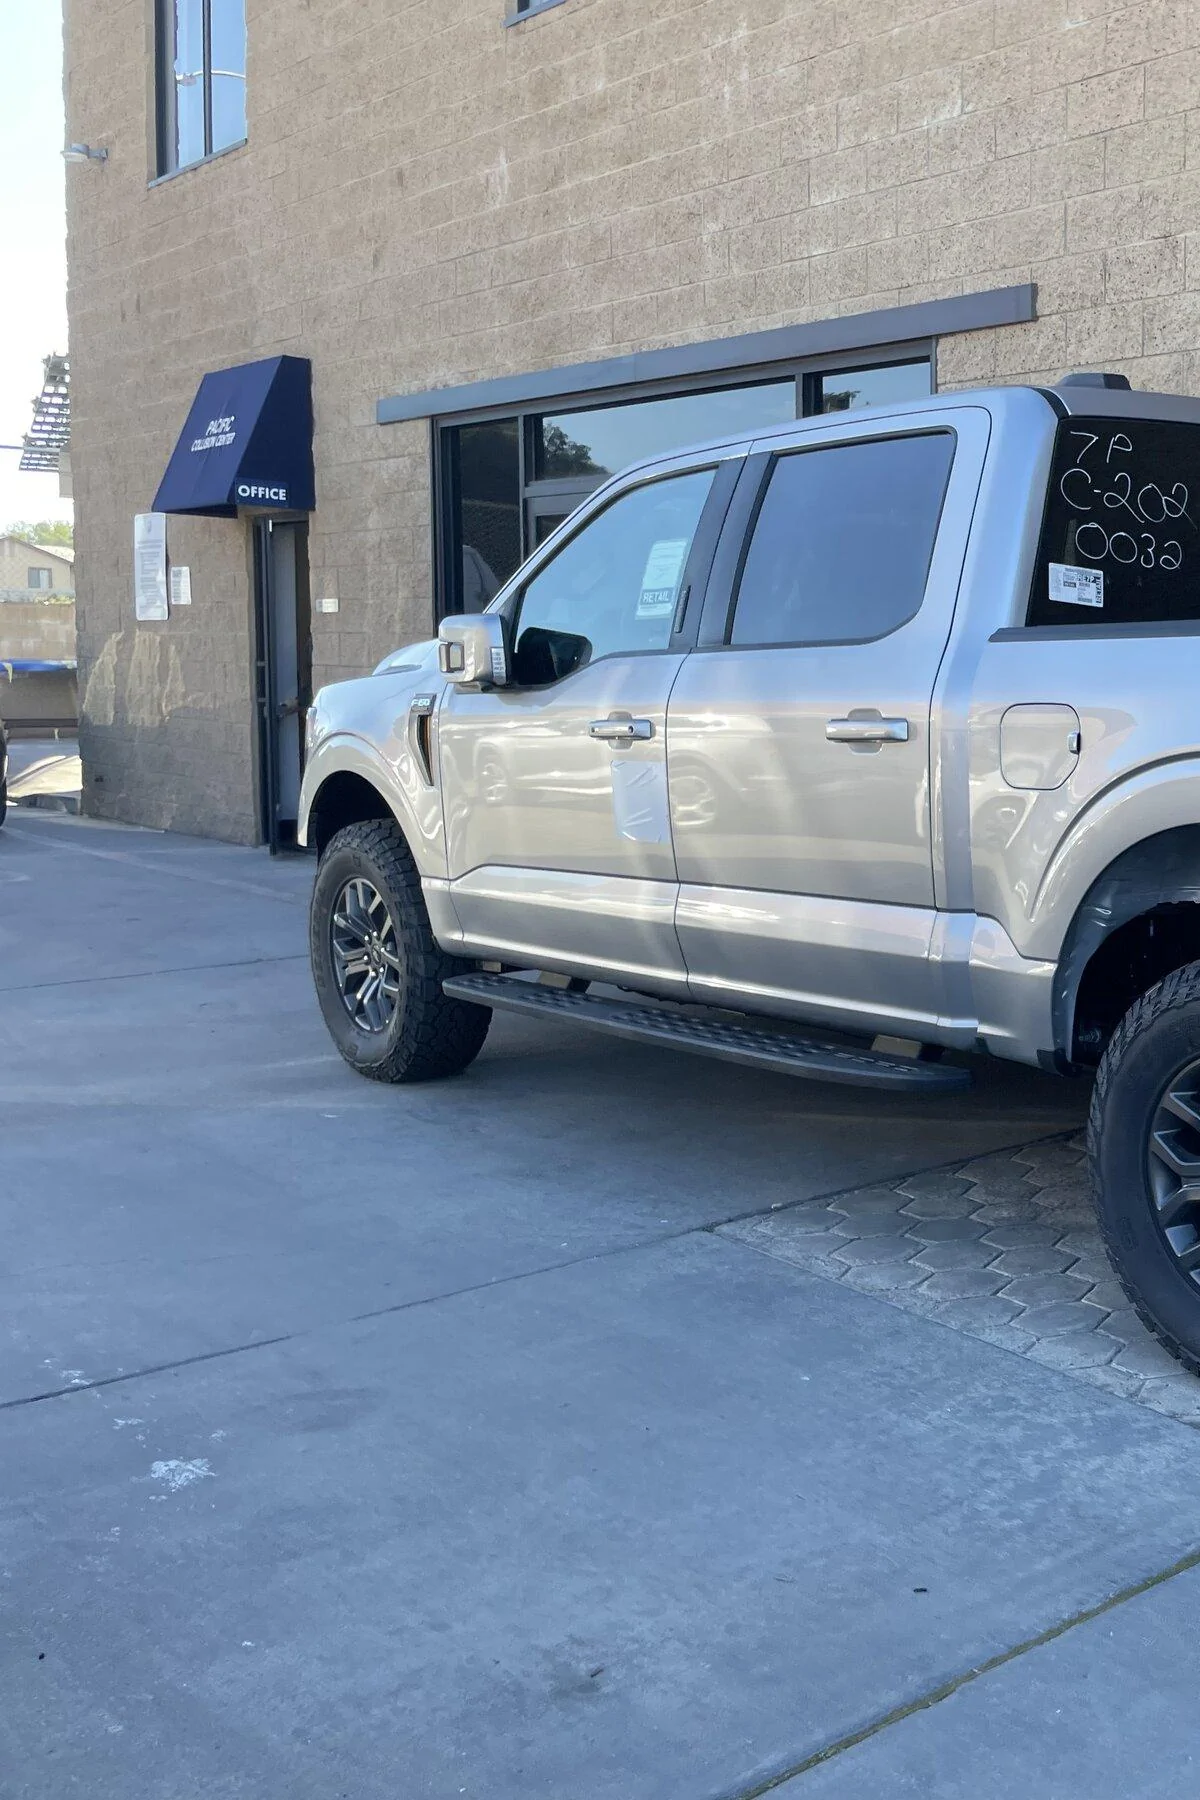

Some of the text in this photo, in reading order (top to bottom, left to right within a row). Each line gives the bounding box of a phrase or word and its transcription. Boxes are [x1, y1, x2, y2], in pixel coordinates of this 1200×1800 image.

[206, 416, 234, 435] PACIFIC
[238, 485, 287, 500] OFFICE
[642, 591, 669, 604] RETAIL
